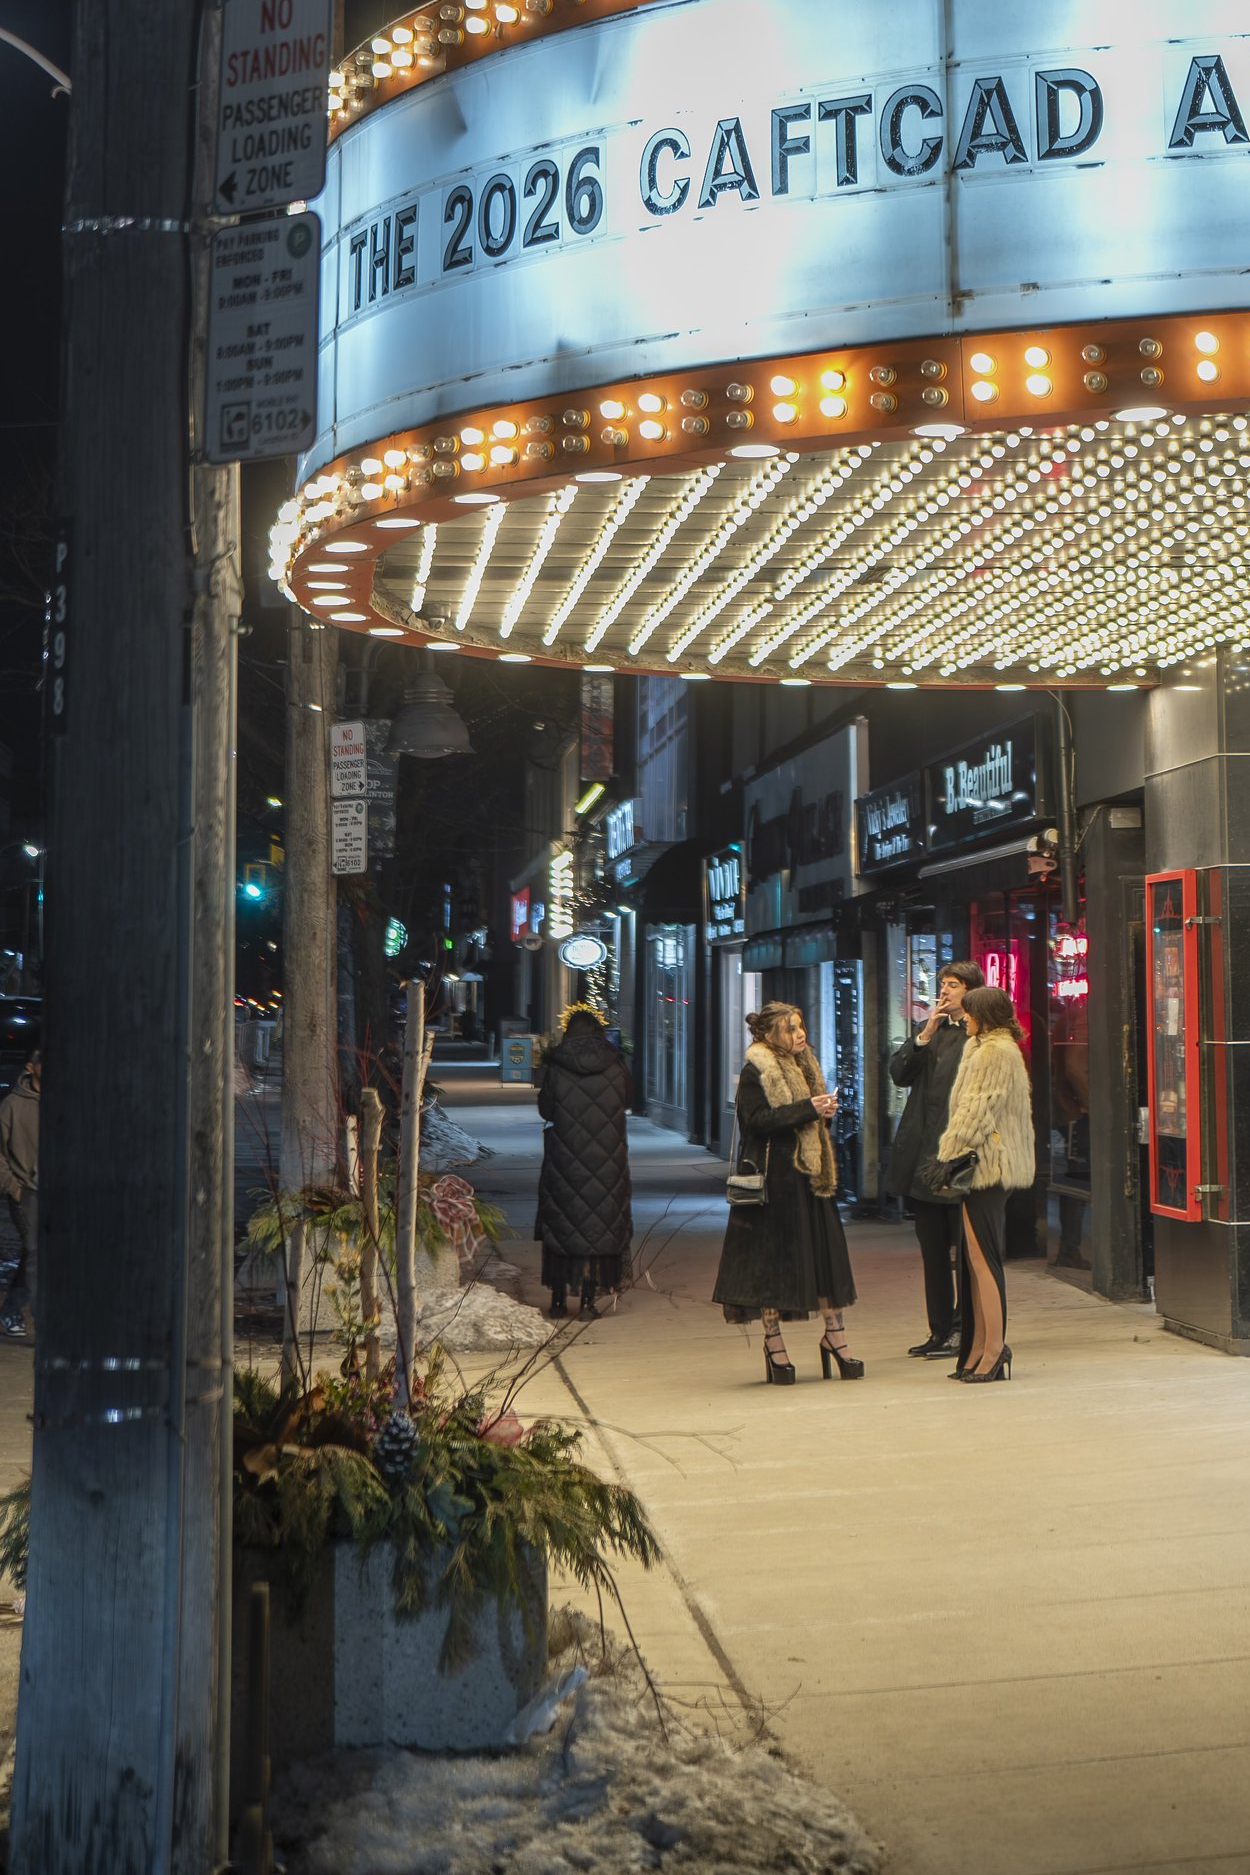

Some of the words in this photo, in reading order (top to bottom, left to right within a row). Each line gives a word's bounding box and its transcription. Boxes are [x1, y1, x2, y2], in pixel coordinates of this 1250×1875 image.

[226, 33, 325, 88] STANDING
[222, 86, 323, 131] PASSENGER
[231, 123, 312, 163] LOADING
[245, 161, 293, 196] ZONE
[350, 204, 418, 311] THE
[443, 146, 603, 273] 2026
[640, 67, 1105, 217] CAFTCAD
[232, 273, 261, 290] MON
[272, 269, 292, 284] FRI
[246, 322, 271, 338] SAT
[252, 408, 299, 435] 6102
[342, 729, 353, 741] NO
[333, 743, 364, 757] STANDING
[333, 759, 364, 770] PASSENGER
[336, 771, 361, 781] LOADING
[341, 782, 357, 791] ZONE
